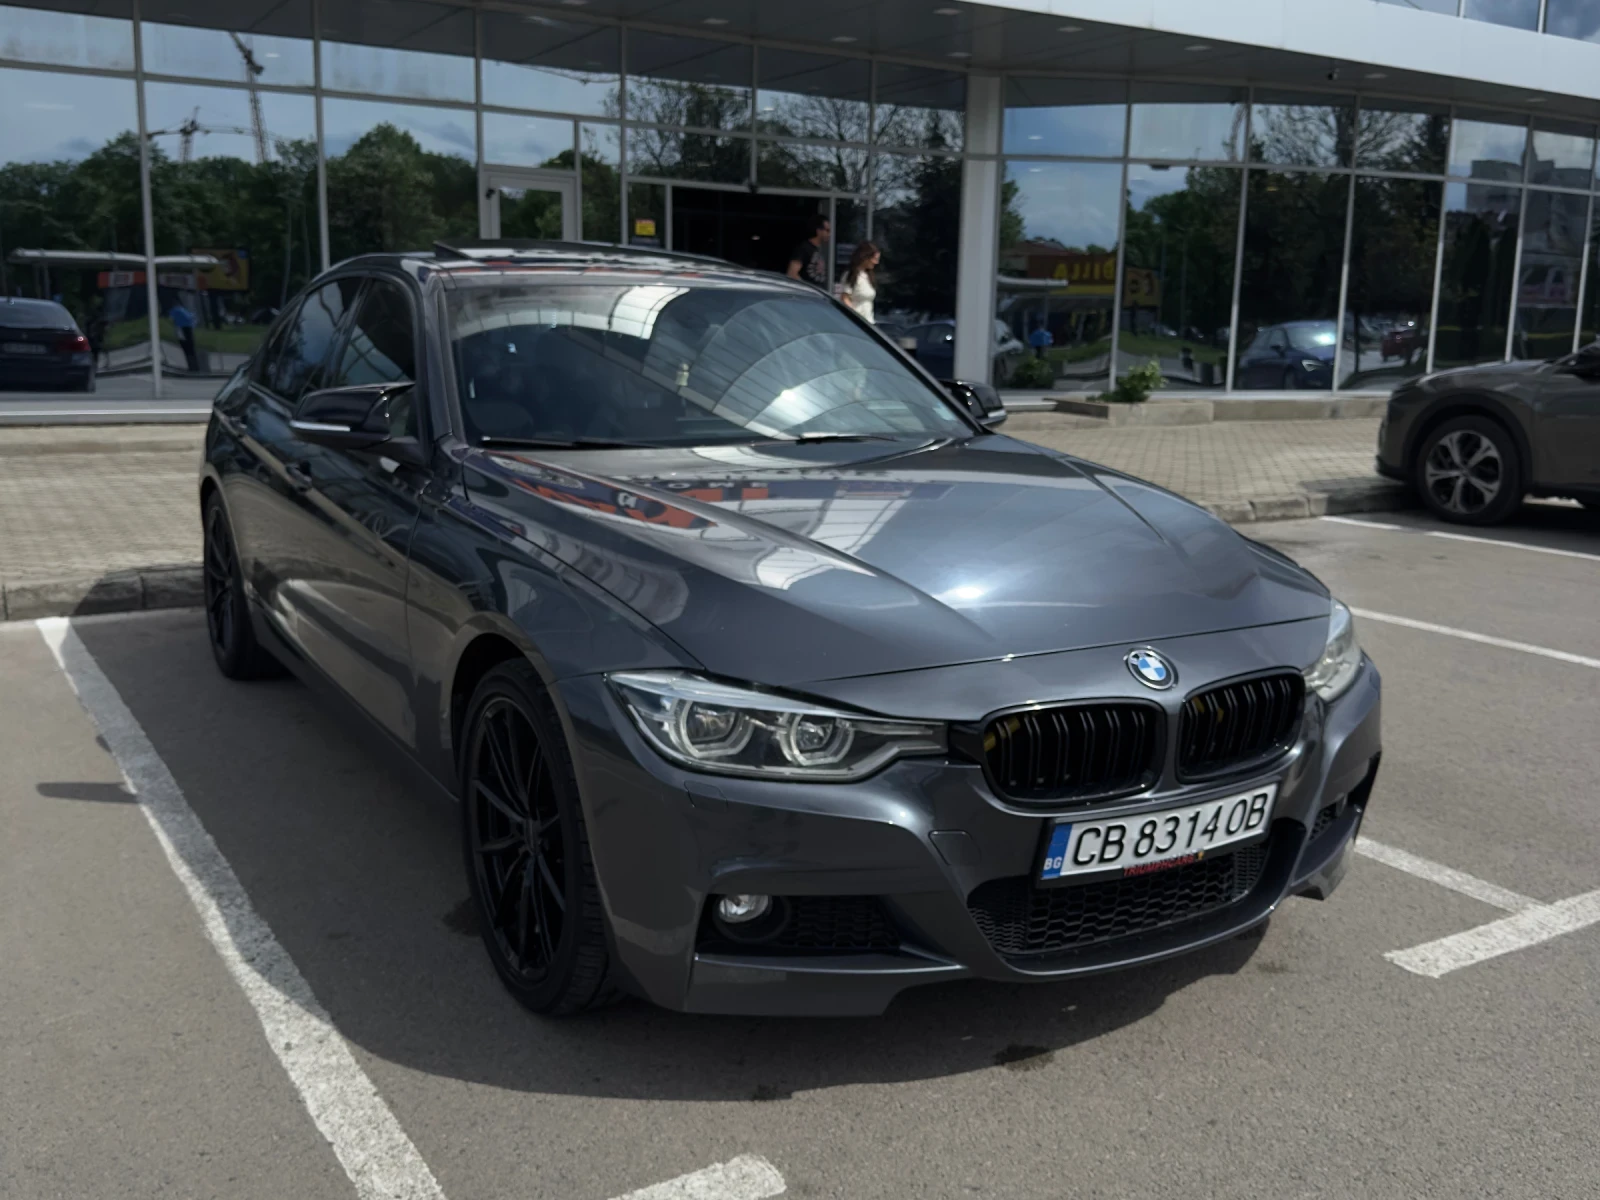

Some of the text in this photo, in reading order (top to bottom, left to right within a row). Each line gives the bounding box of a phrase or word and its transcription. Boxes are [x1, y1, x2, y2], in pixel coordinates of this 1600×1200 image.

[1073, 824, 1126, 866] CB
[1134, 805, 1223, 858] 8314
[1043, 857, 1062, 871] BG
